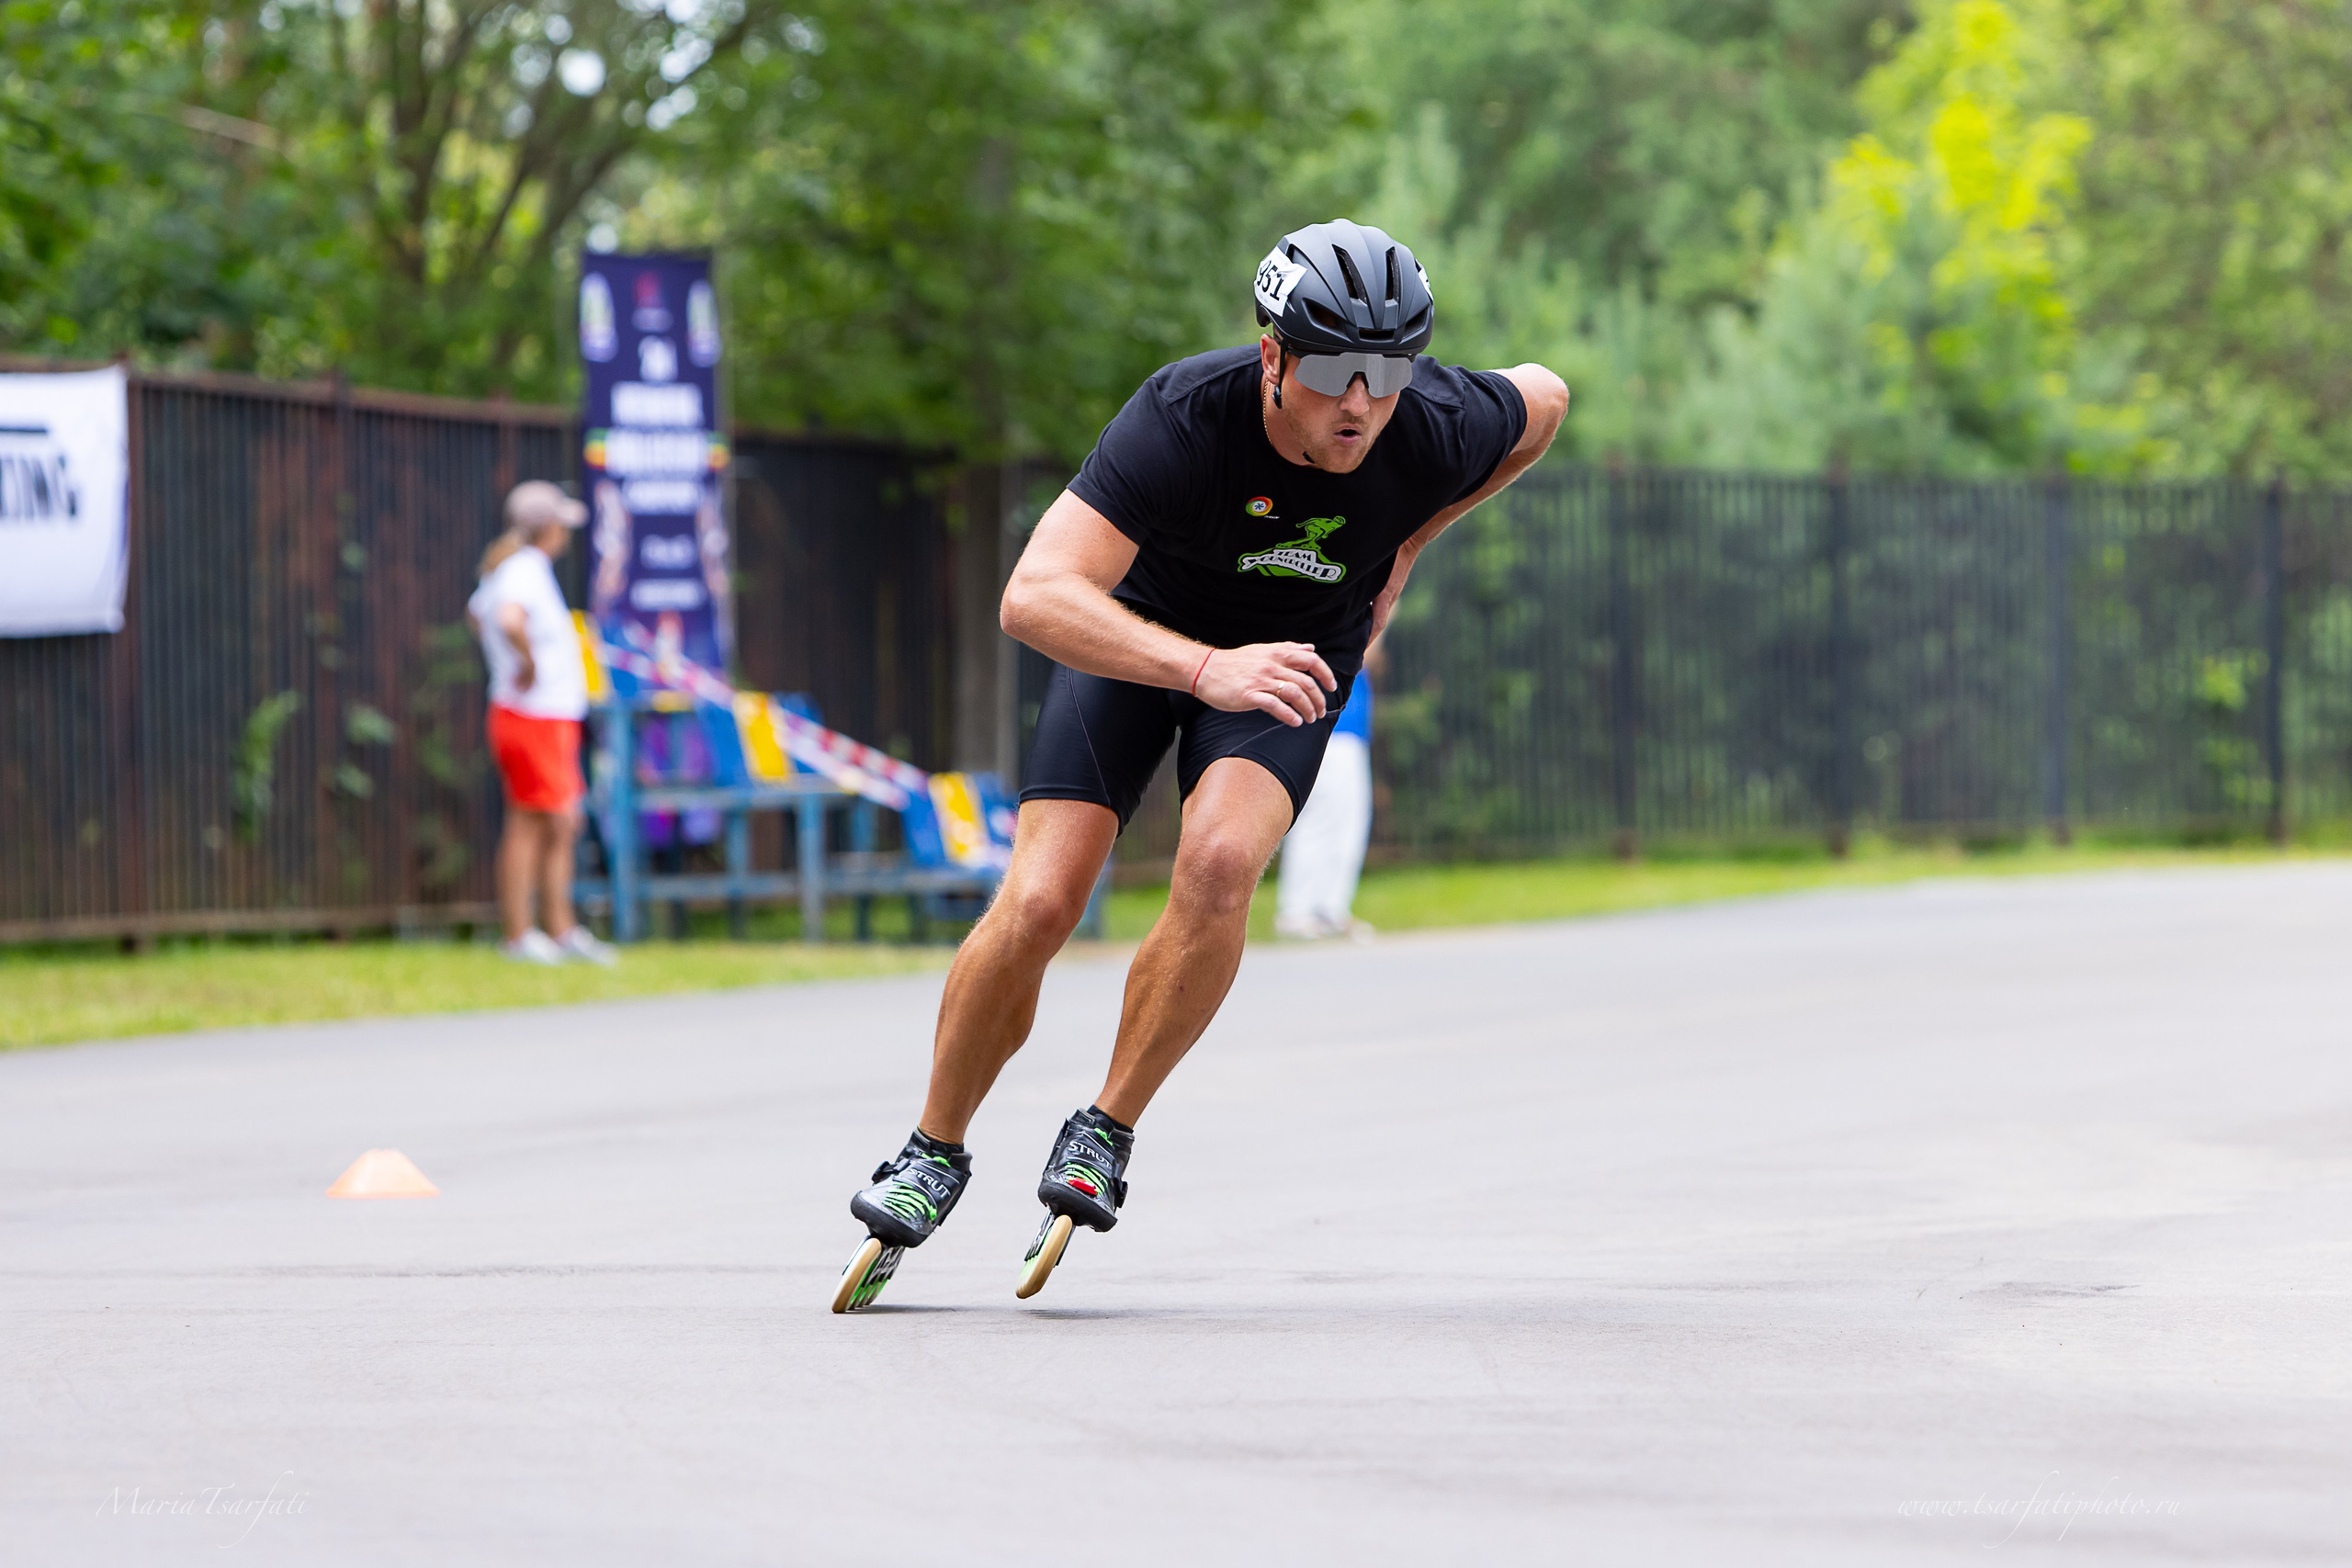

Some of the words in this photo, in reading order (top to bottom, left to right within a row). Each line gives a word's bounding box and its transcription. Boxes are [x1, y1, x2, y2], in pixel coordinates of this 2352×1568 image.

[1276, 550, 1312, 562] TEAM
[1068, 1140, 1113, 1169] STRUT
[907, 1167, 951, 1200] STRUT
